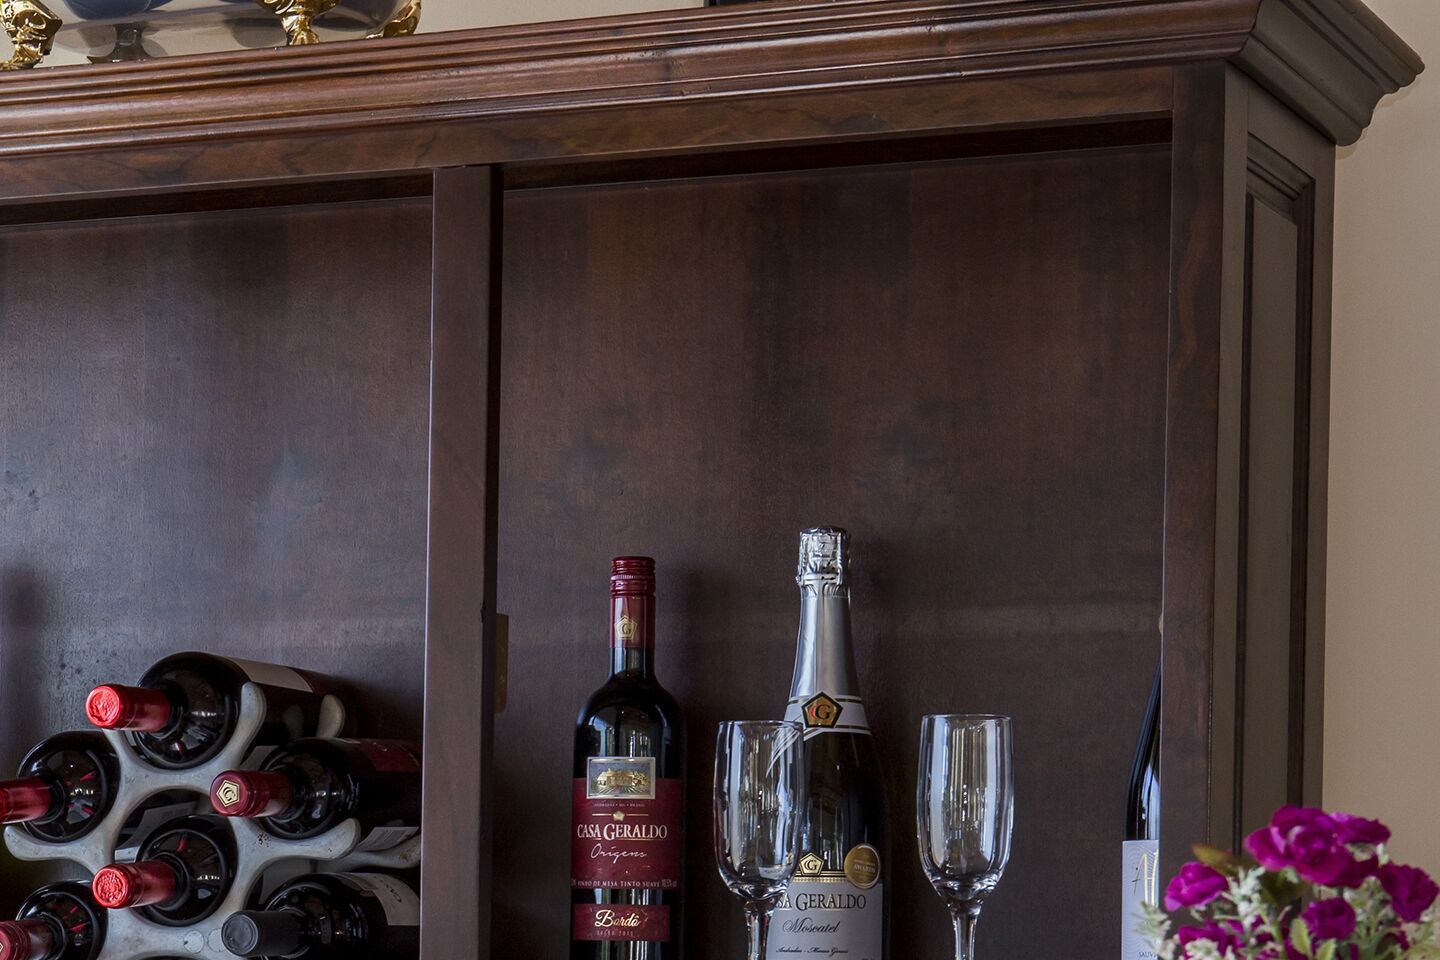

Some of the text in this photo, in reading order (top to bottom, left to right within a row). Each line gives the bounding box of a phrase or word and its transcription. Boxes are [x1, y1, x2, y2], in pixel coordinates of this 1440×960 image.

[577, 823, 668, 840] CASA GERALDO
[590, 843, 647, 864] Origens
[795, 893, 867, 912] GERALDO
[594, 909, 641, 928] Bordô
[782, 917, 841, 933] Moscatel
